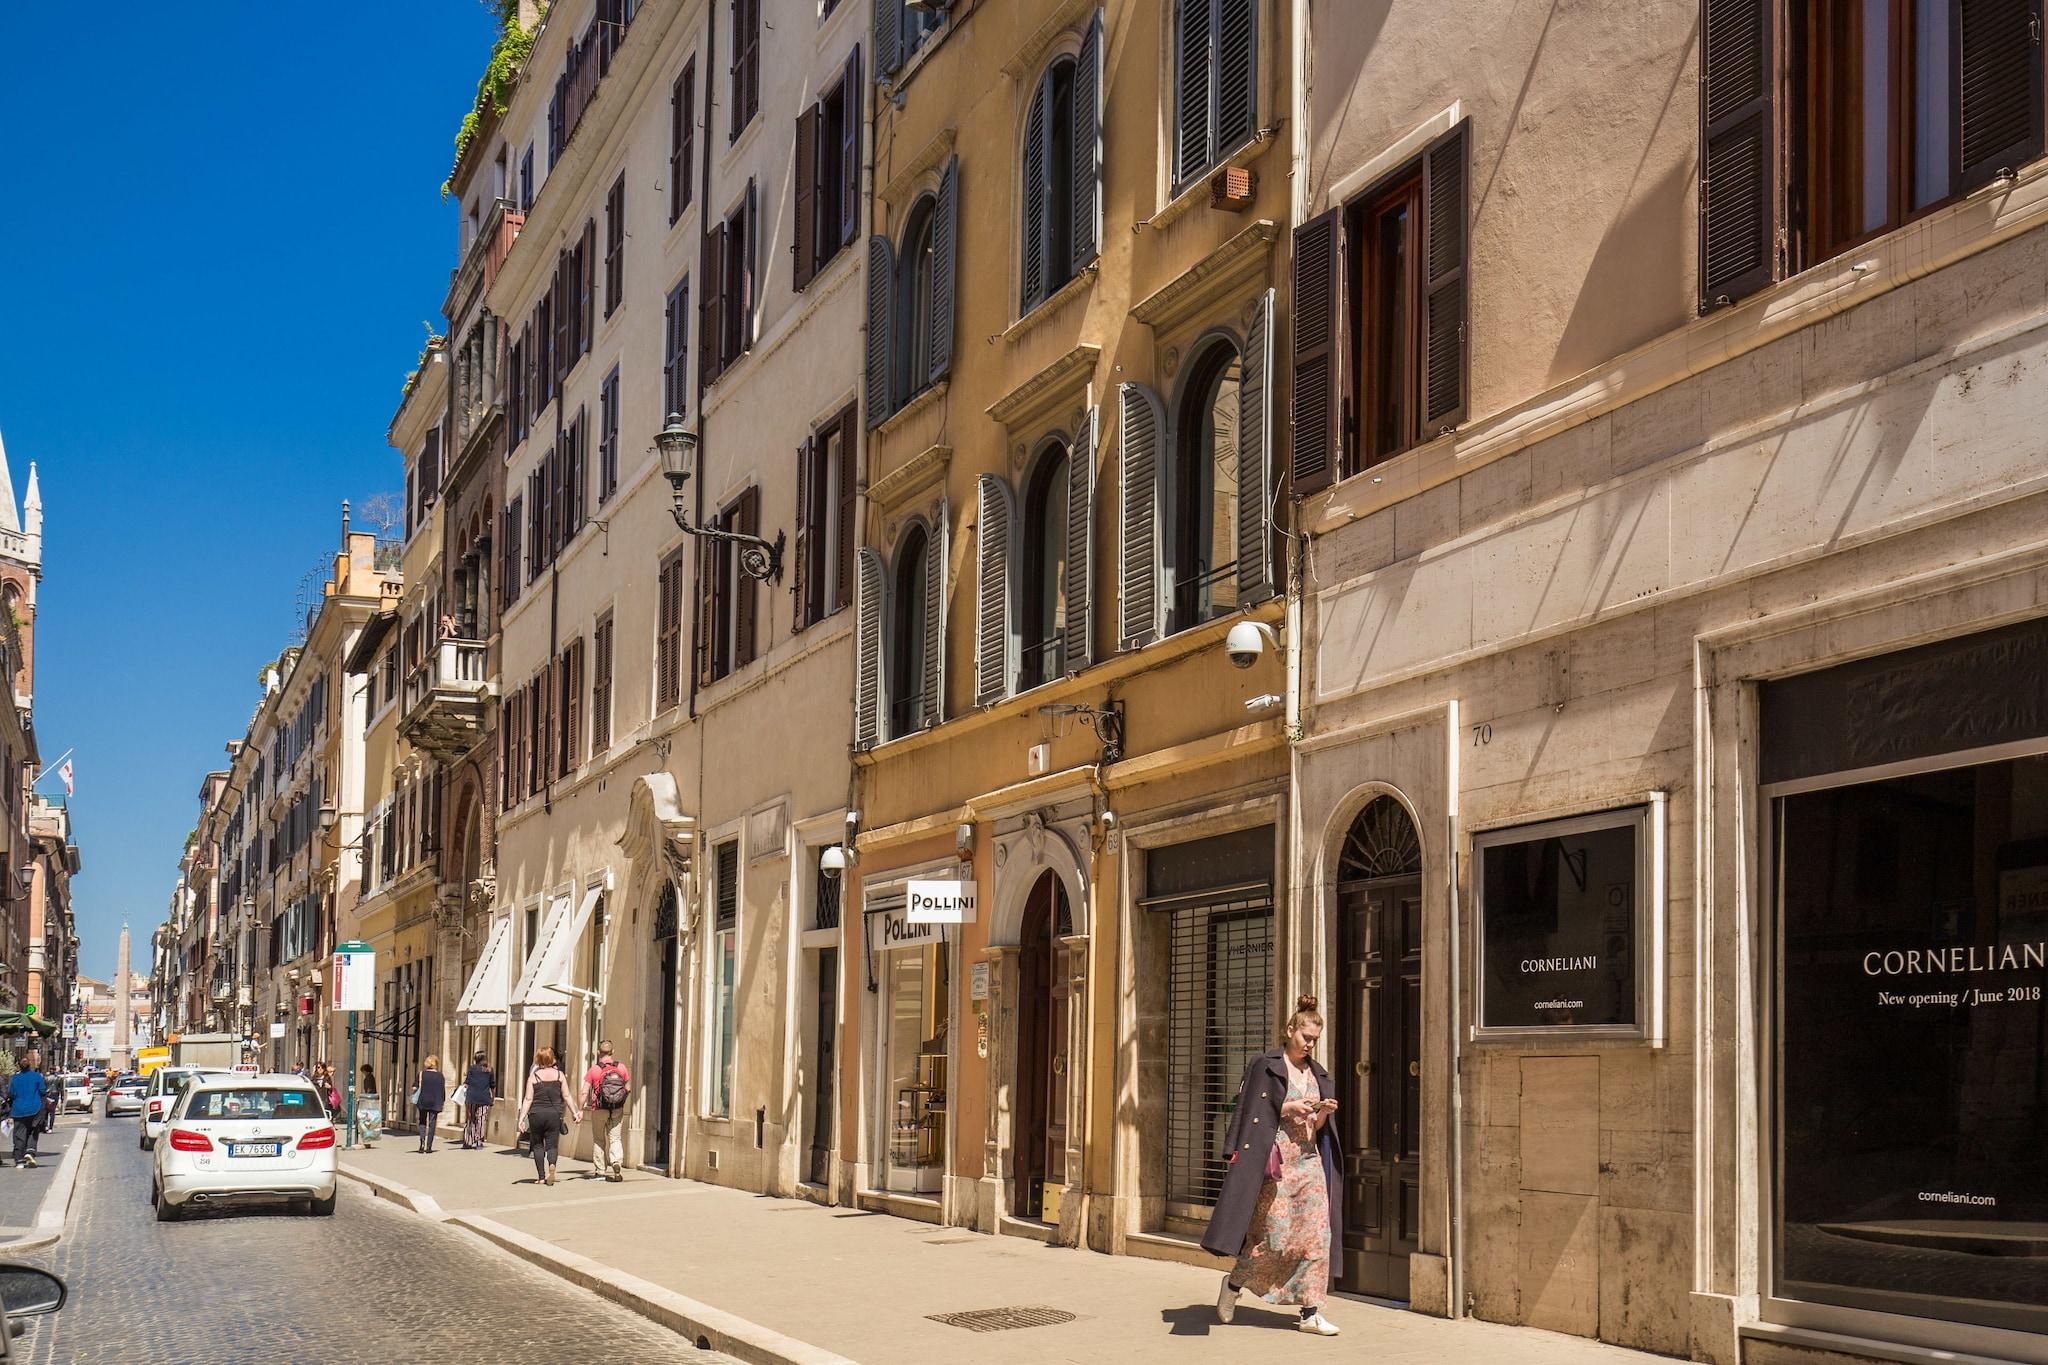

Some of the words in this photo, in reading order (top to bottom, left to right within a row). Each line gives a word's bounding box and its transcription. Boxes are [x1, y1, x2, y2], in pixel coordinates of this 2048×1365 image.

[1472, 724, 1492, 747] 70
[1107, 832, 1119, 850] 69
[911, 893, 975, 912] POLLINI
[884, 913, 931, 946] POLLINI
[1520, 955, 1597, 973] CORNELIANI
[1863, 942, 2046, 976] CORNELIAN
[1533, 998, 1584, 1010] corneliani.com
[1878, 991, 1905, 1006] New
[1908, 991, 1959, 1008] opening
[1961, 989, 1970, 1003] /
[1970, 988, 2004, 1007] June
[2007, 986, 2041, 1001] 2018
[1917, 1191, 1996, 1207] corneliani.com
